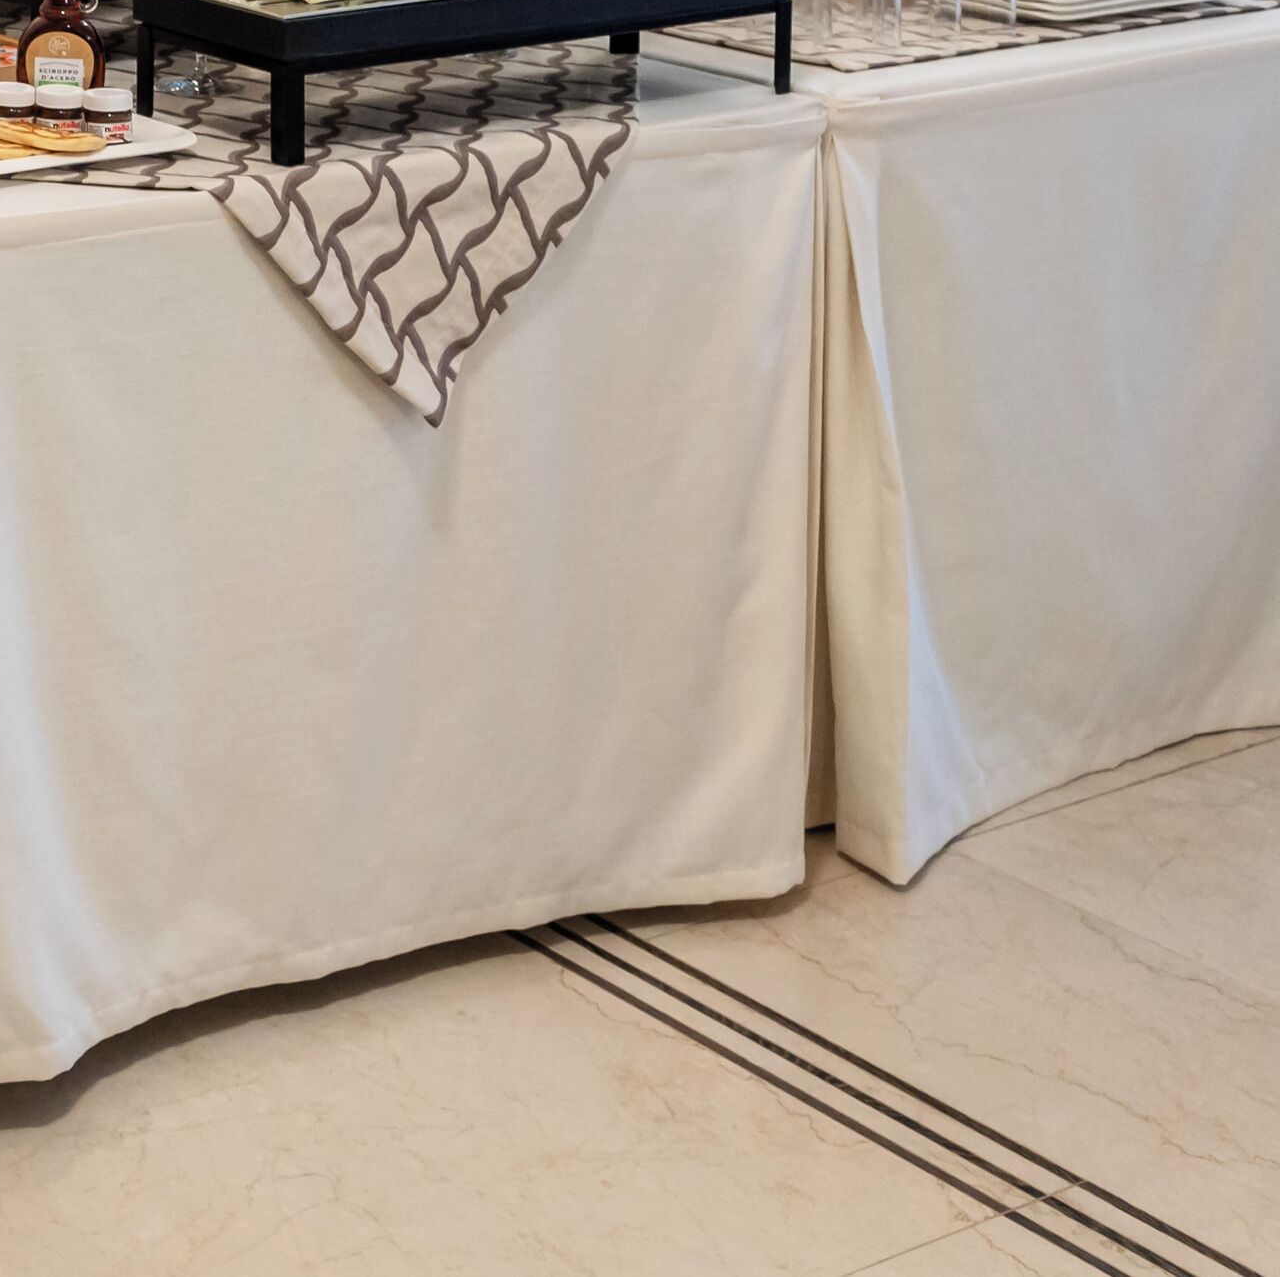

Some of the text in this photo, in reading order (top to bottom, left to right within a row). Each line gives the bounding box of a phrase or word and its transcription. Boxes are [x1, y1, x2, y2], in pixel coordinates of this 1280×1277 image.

[39, 67, 79, 75] SCIROPPO
[53, 120, 80, 129] nutella
[105, 123, 130, 132] nutella
